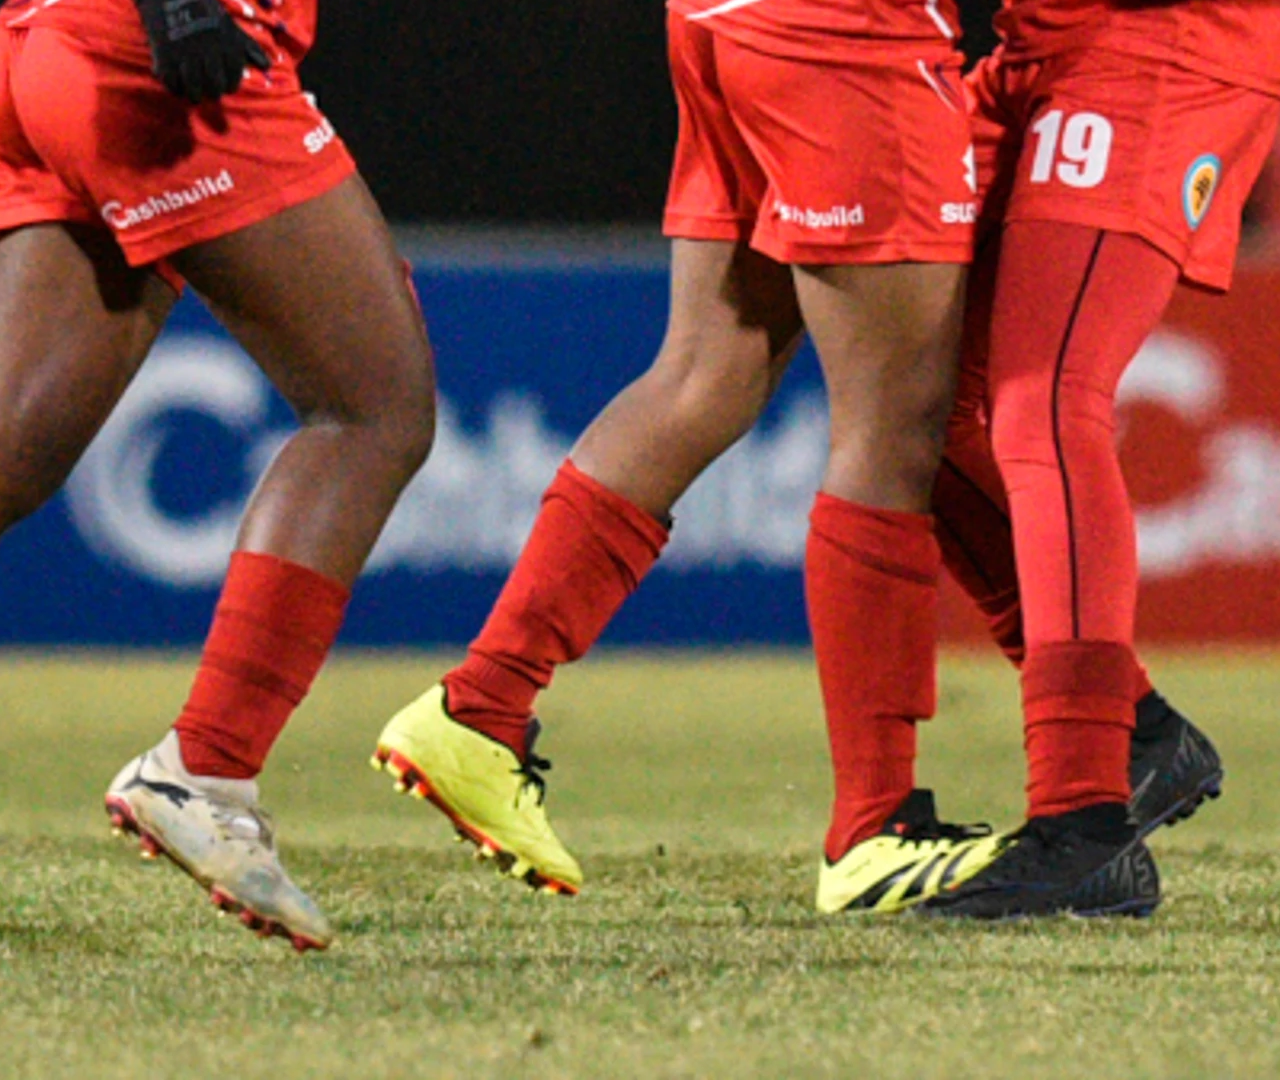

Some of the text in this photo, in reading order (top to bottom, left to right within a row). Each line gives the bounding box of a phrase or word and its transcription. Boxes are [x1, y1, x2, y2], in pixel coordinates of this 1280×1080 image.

[1030, 109, 1113, 188] 19
[101, 169, 234, 229] Cashbuild
[774, 199, 864, 227] shbuild
